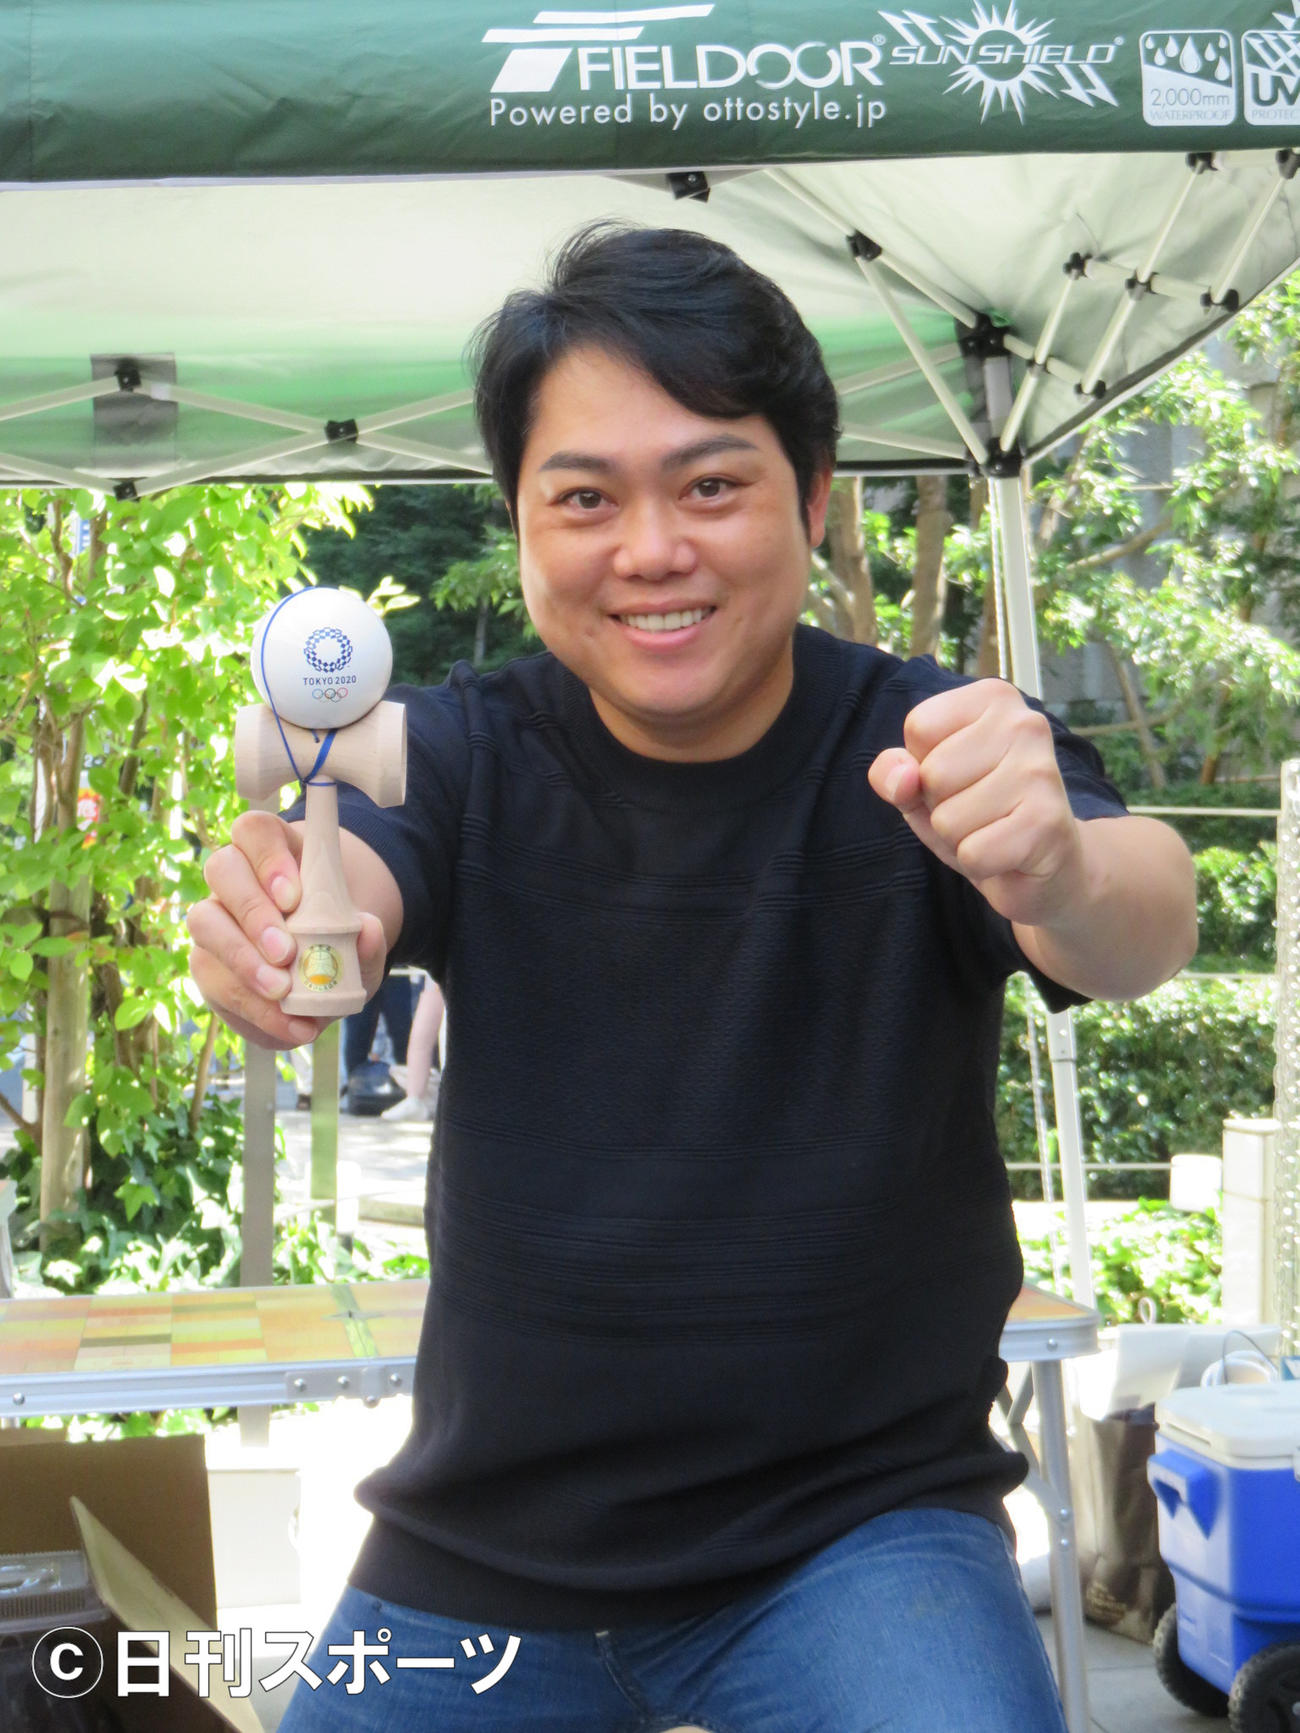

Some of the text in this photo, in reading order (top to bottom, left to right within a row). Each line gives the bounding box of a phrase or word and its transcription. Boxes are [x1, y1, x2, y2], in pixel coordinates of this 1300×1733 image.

[1150, 88, 1230, 109] 2,000mm
[489, 90, 886, 130] Powered by ottostyle.jp
[1150, 110, 1231, 120] WATERPROOF
[303, 675, 357, 686] TOKYO 2020
